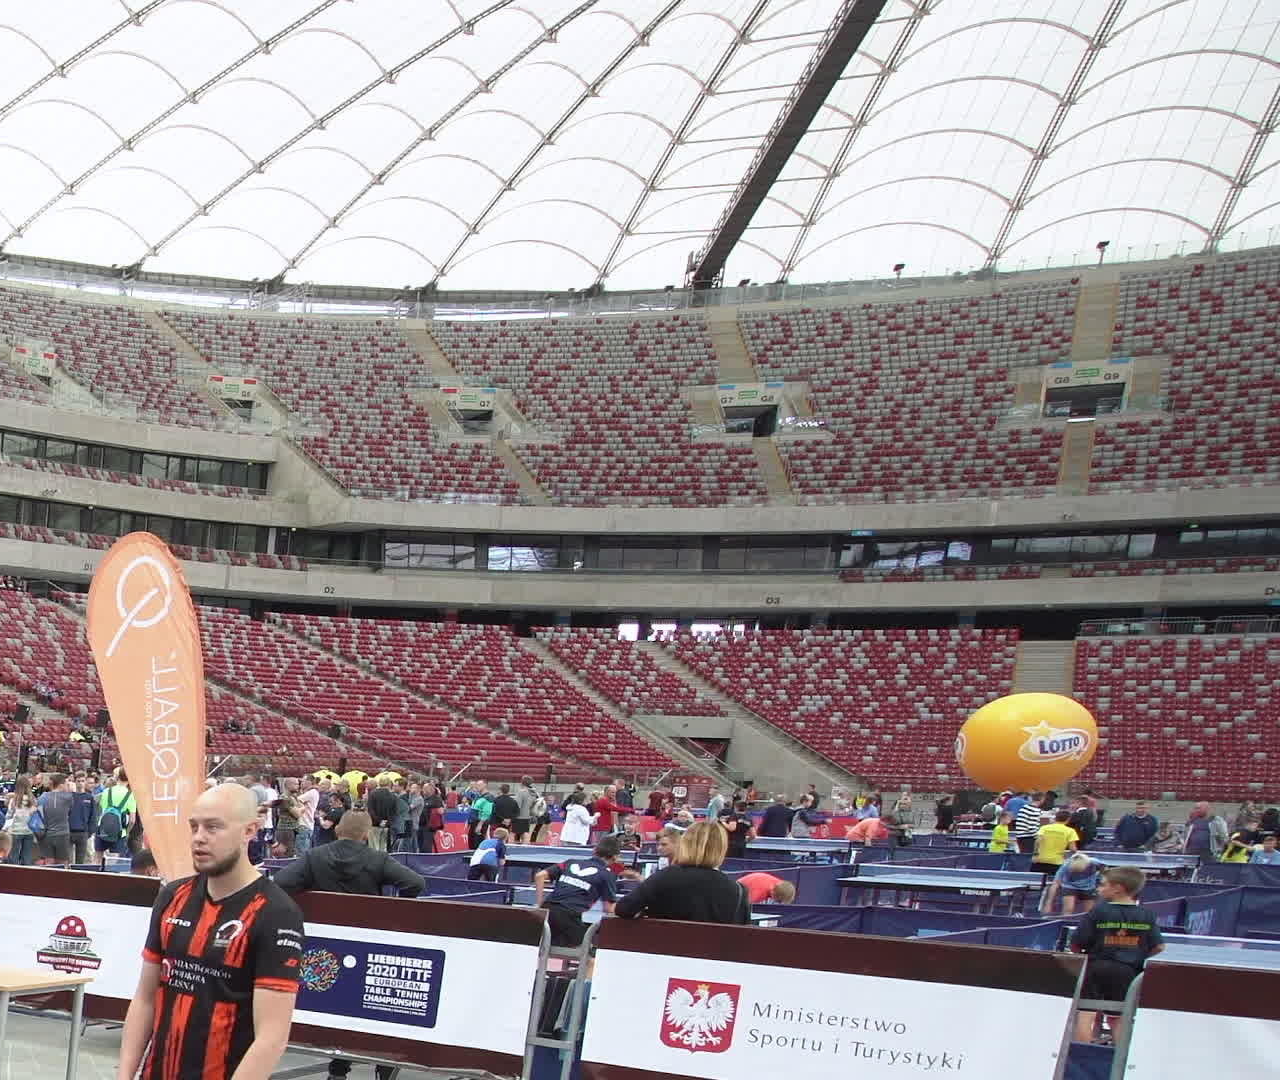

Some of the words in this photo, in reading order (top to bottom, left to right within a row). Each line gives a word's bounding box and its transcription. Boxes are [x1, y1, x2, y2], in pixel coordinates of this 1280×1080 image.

[324, 586, 335, 594] D2
[765, 596, 781, 605] D3
[1039, 736, 1080, 754] LOTTO
[367, 953, 433, 970] LIEBHERR
[365, 964, 398, 978] 2020
[401, 967, 433, 982] ITTF
[373, 977, 422, 991] EUROPEAN
[364, 985, 391, 996] TABLE
[396, 989, 429, 1001] TENNIS
[362, 994, 428, 1009] CHAMPIONSHIPS
[752, 1002, 907, 1035] Ministerstwo
[747, 1028, 823, 1053] Sportu
[833, 1038, 841, 1055] i
[850, 1041, 965, 1071] Turystyki
